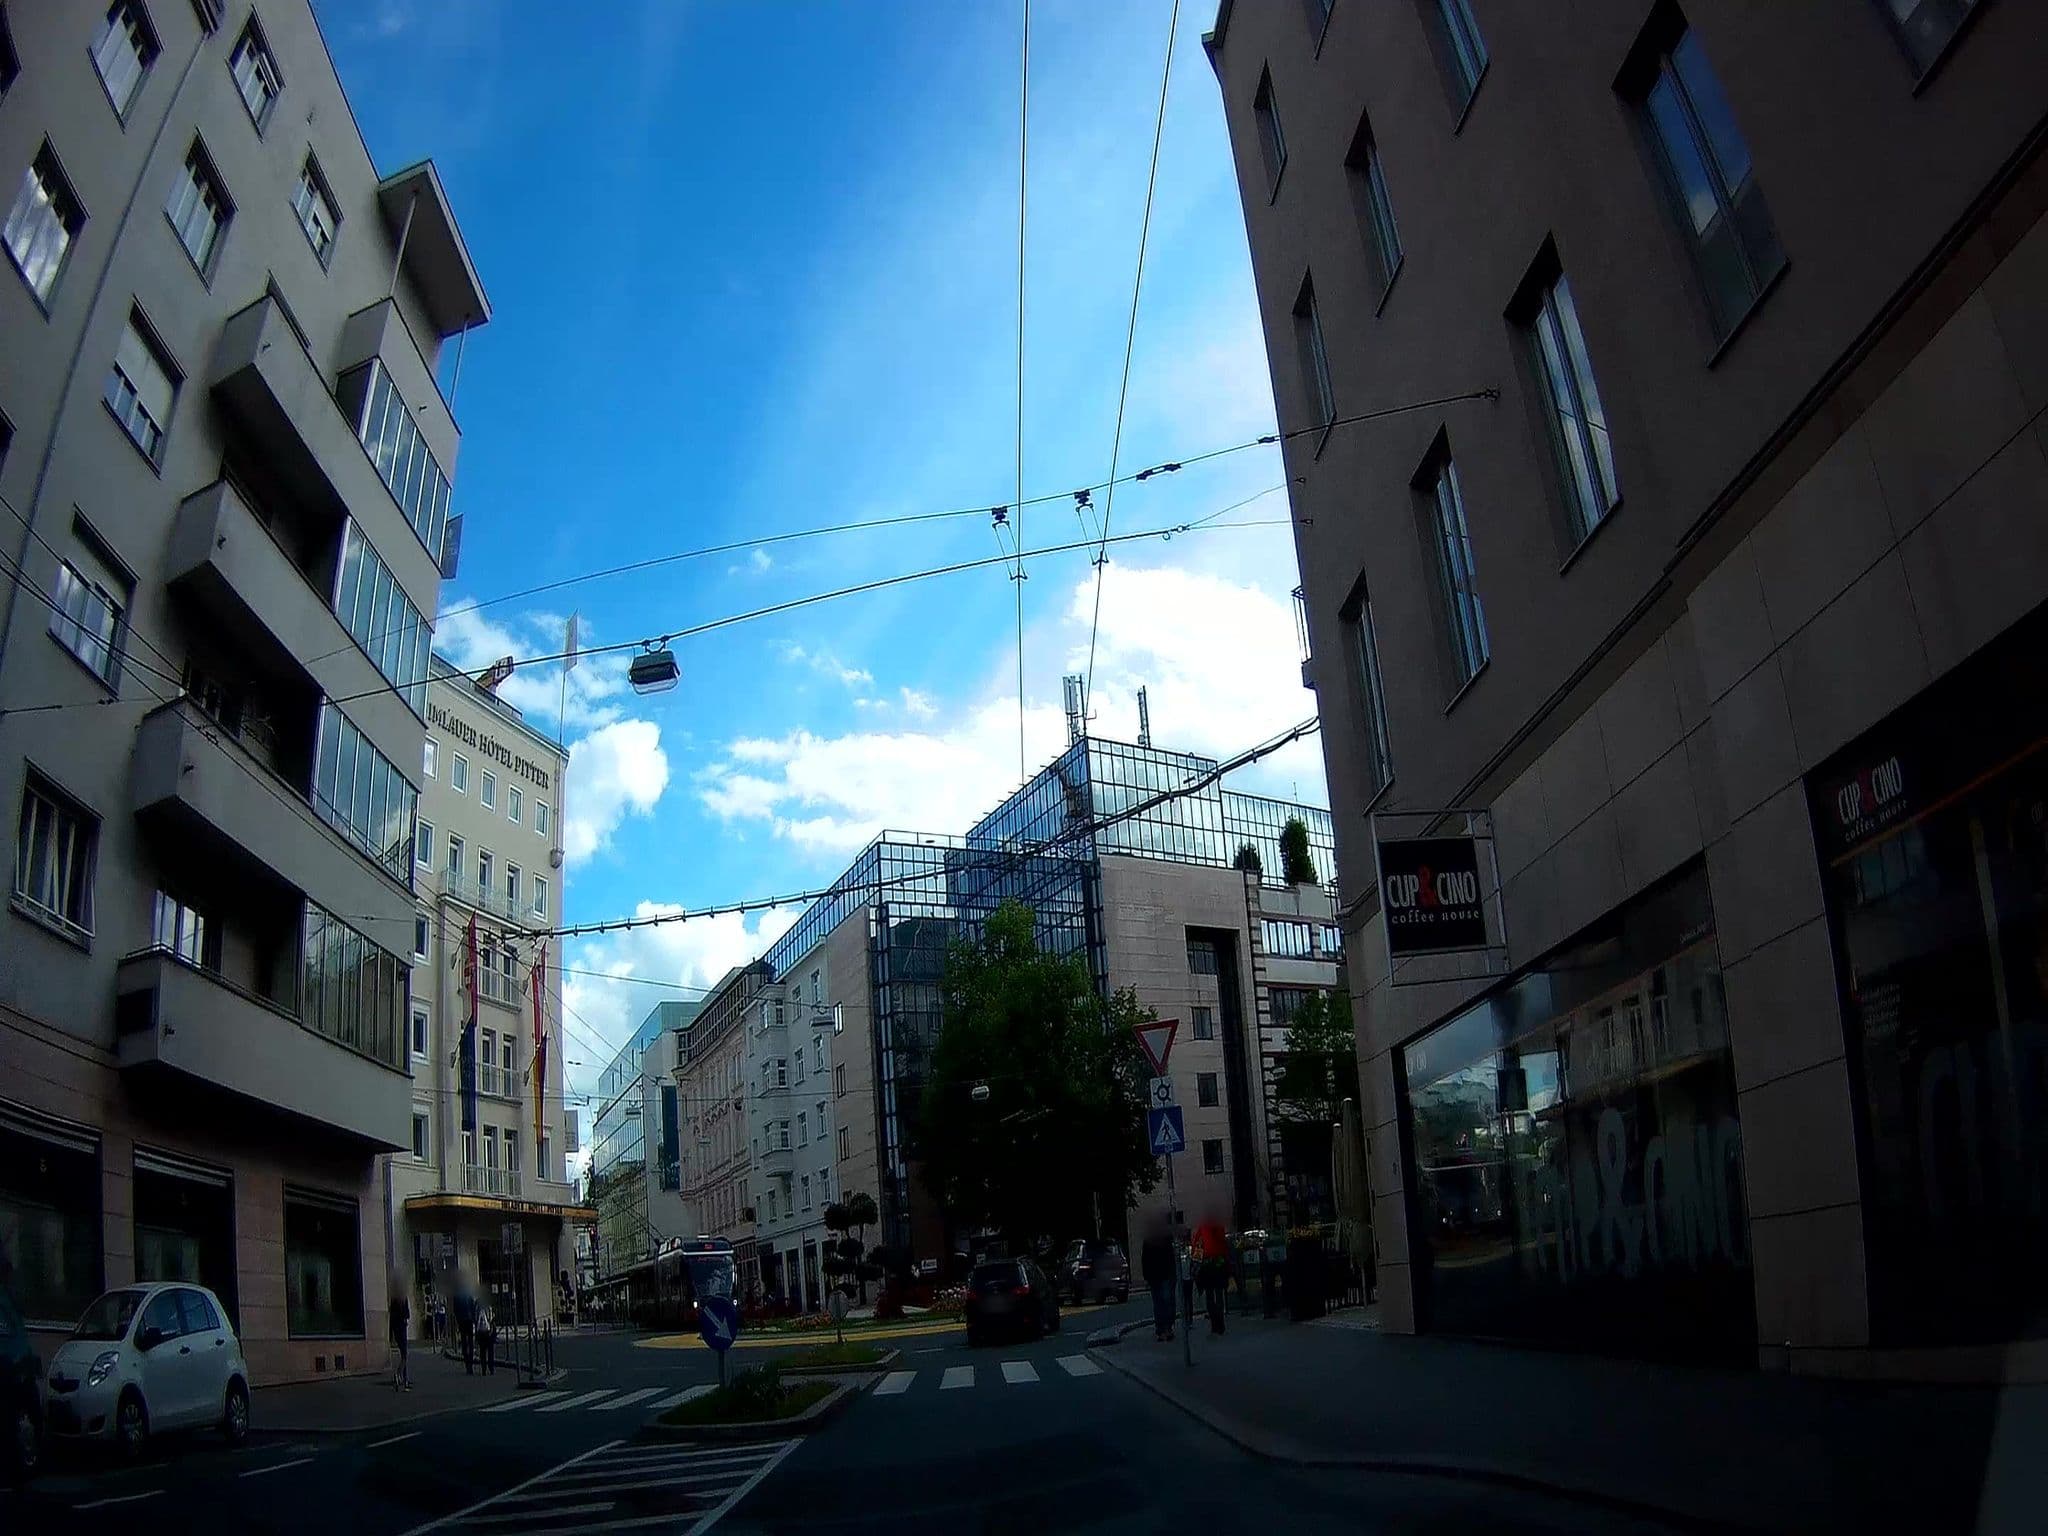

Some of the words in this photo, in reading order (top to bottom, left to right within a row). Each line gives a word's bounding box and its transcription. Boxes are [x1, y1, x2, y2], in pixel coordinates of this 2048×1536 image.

[427, 703, 477, 748] IMLAUER
[479, 733, 512, 769] HOTEL
[515, 756, 549, 790] PITTER
[1391, 909, 1436, 925] coffee
